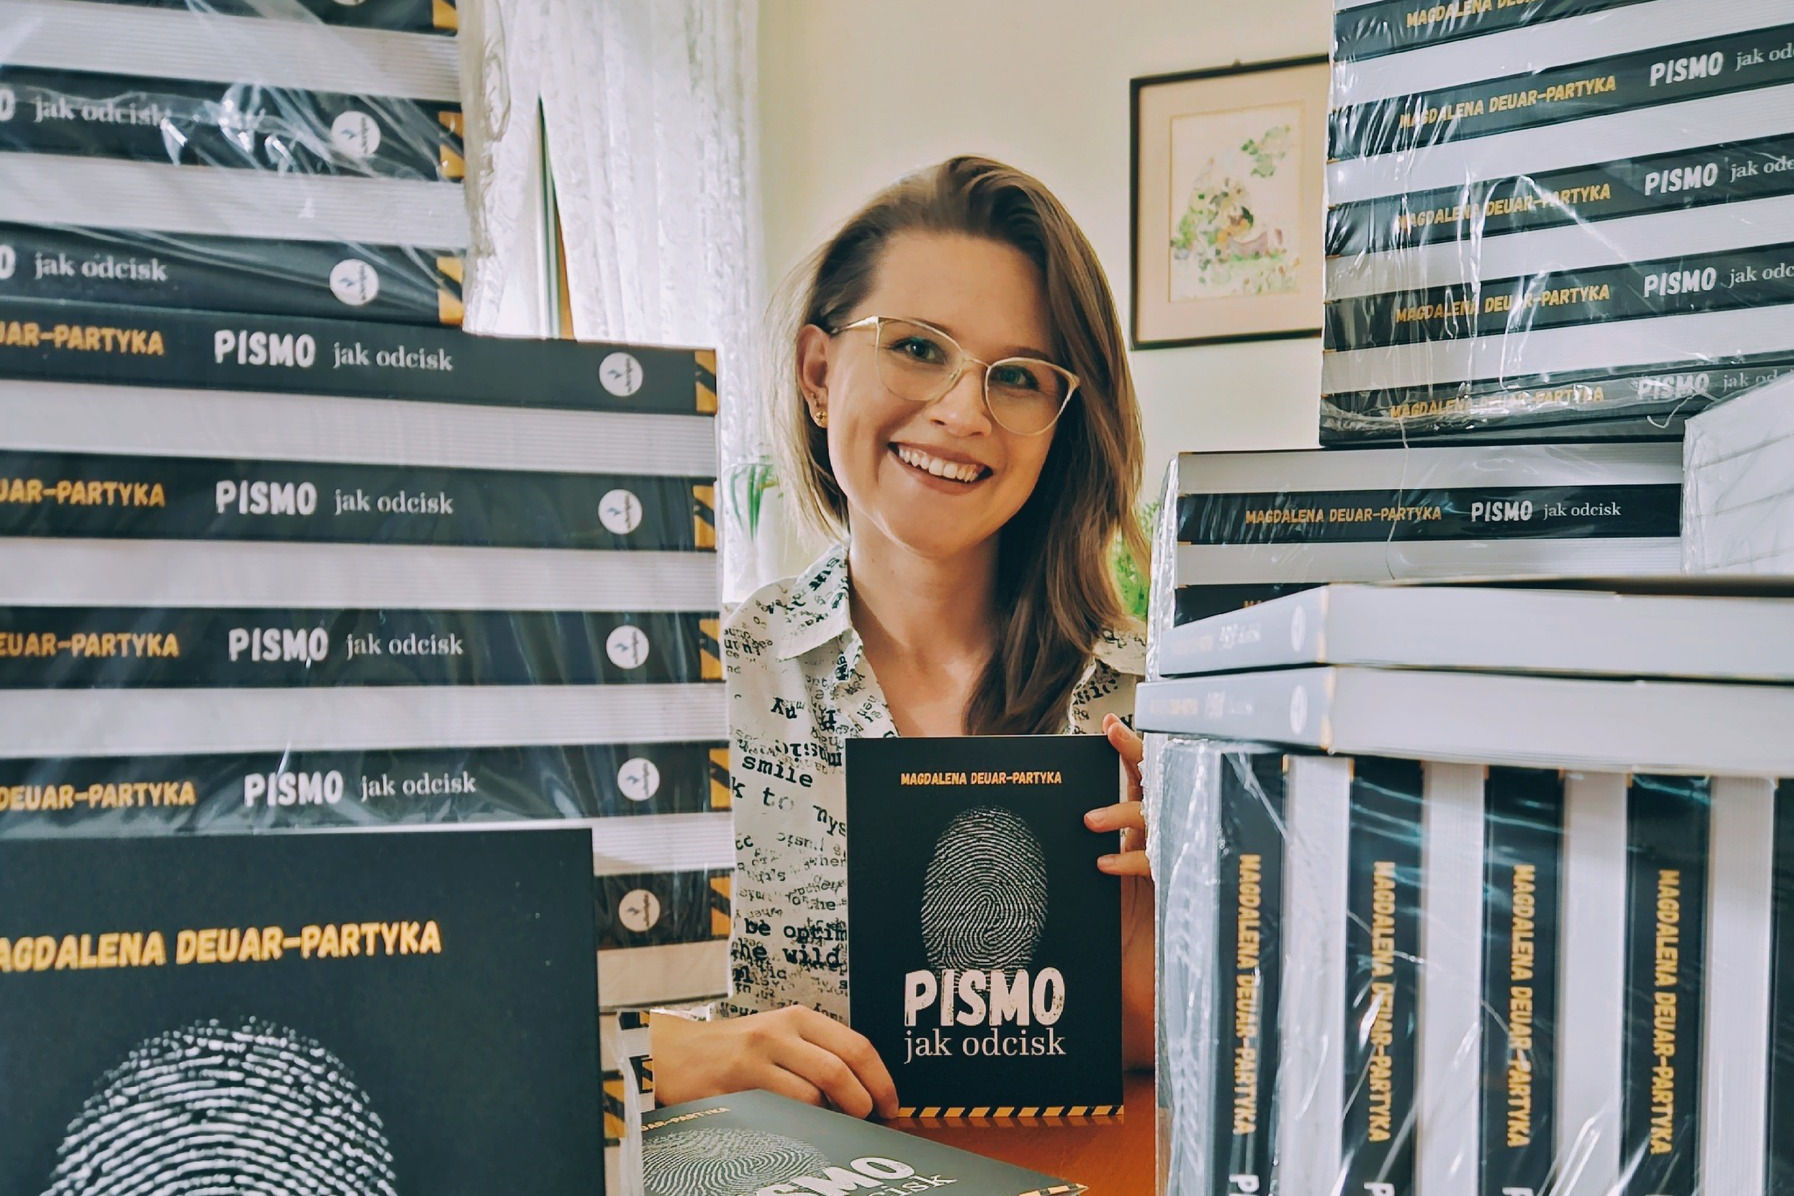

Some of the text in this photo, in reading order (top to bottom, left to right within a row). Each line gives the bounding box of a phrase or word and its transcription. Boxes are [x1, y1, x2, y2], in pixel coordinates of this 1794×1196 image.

[1406, 0, 1492, 28] MAGDALENA
[1400, 101, 1484, 128] MAGDALENA
[1489, 75, 1616, 113] DEUAR-PARTYKA
[1650, 51, 1724, 87] PISMO
[1735, 48, 1765, 71] jak
[34, 95, 75, 123] jak
[1644, 162, 1718, 196] PISMO
[1730, 160, 1758, 183] jak
[34, 251, 75, 280] jak
[81, 254, 168, 281] odcisk
[1643, 266, 1717, 298] PISMO
[1728, 265, 1757, 289] jak
[214, 329, 316, 368] PISMO
[333, 342, 370, 369] jak
[376, 345, 453, 372] odcisk
[1637, 373, 1709, 401] PISMO
[1722, 373, 1750, 393] jak
[216, 480, 318, 516] PISMO
[334, 489, 370, 515] jak
[377, 491, 453, 515] odcisk
[1246, 500, 1621, 524] MAGDALENA DEUAR-PARTYKA PISMO jak odcisk
[228, 627, 329, 662] PISMO
[346, 633, 382, 660] jak
[388, 633, 464, 656] odcisk
[244, 770, 344, 807] PISMO
[360, 772, 396, 802] jak
[402, 771, 476, 796] odcisk
[742, 755, 813, 788] smile
[901, 771, 1062, 786] MAGDALENA DEUAR-PARTYKA
[176, 920, 442, 965] DEUAR-PARTYKA
[904, 966, 1066, 1027] PISMO
[1233, 854, 1262, 1136] MAGDALENA DEUAR-PARTYKA
[1368, 861, 1396, 1142] MAGDALENA DEUAR-PARTYKA
[1507, 865, 1536, 1148] MAGDALENA DEUAR-PARTYKA
[1650, 870, 1680, 1155] MAGDALENA DEUAR-PARTYKA
[904, 1027, 1066, 1064] jak odcisk
